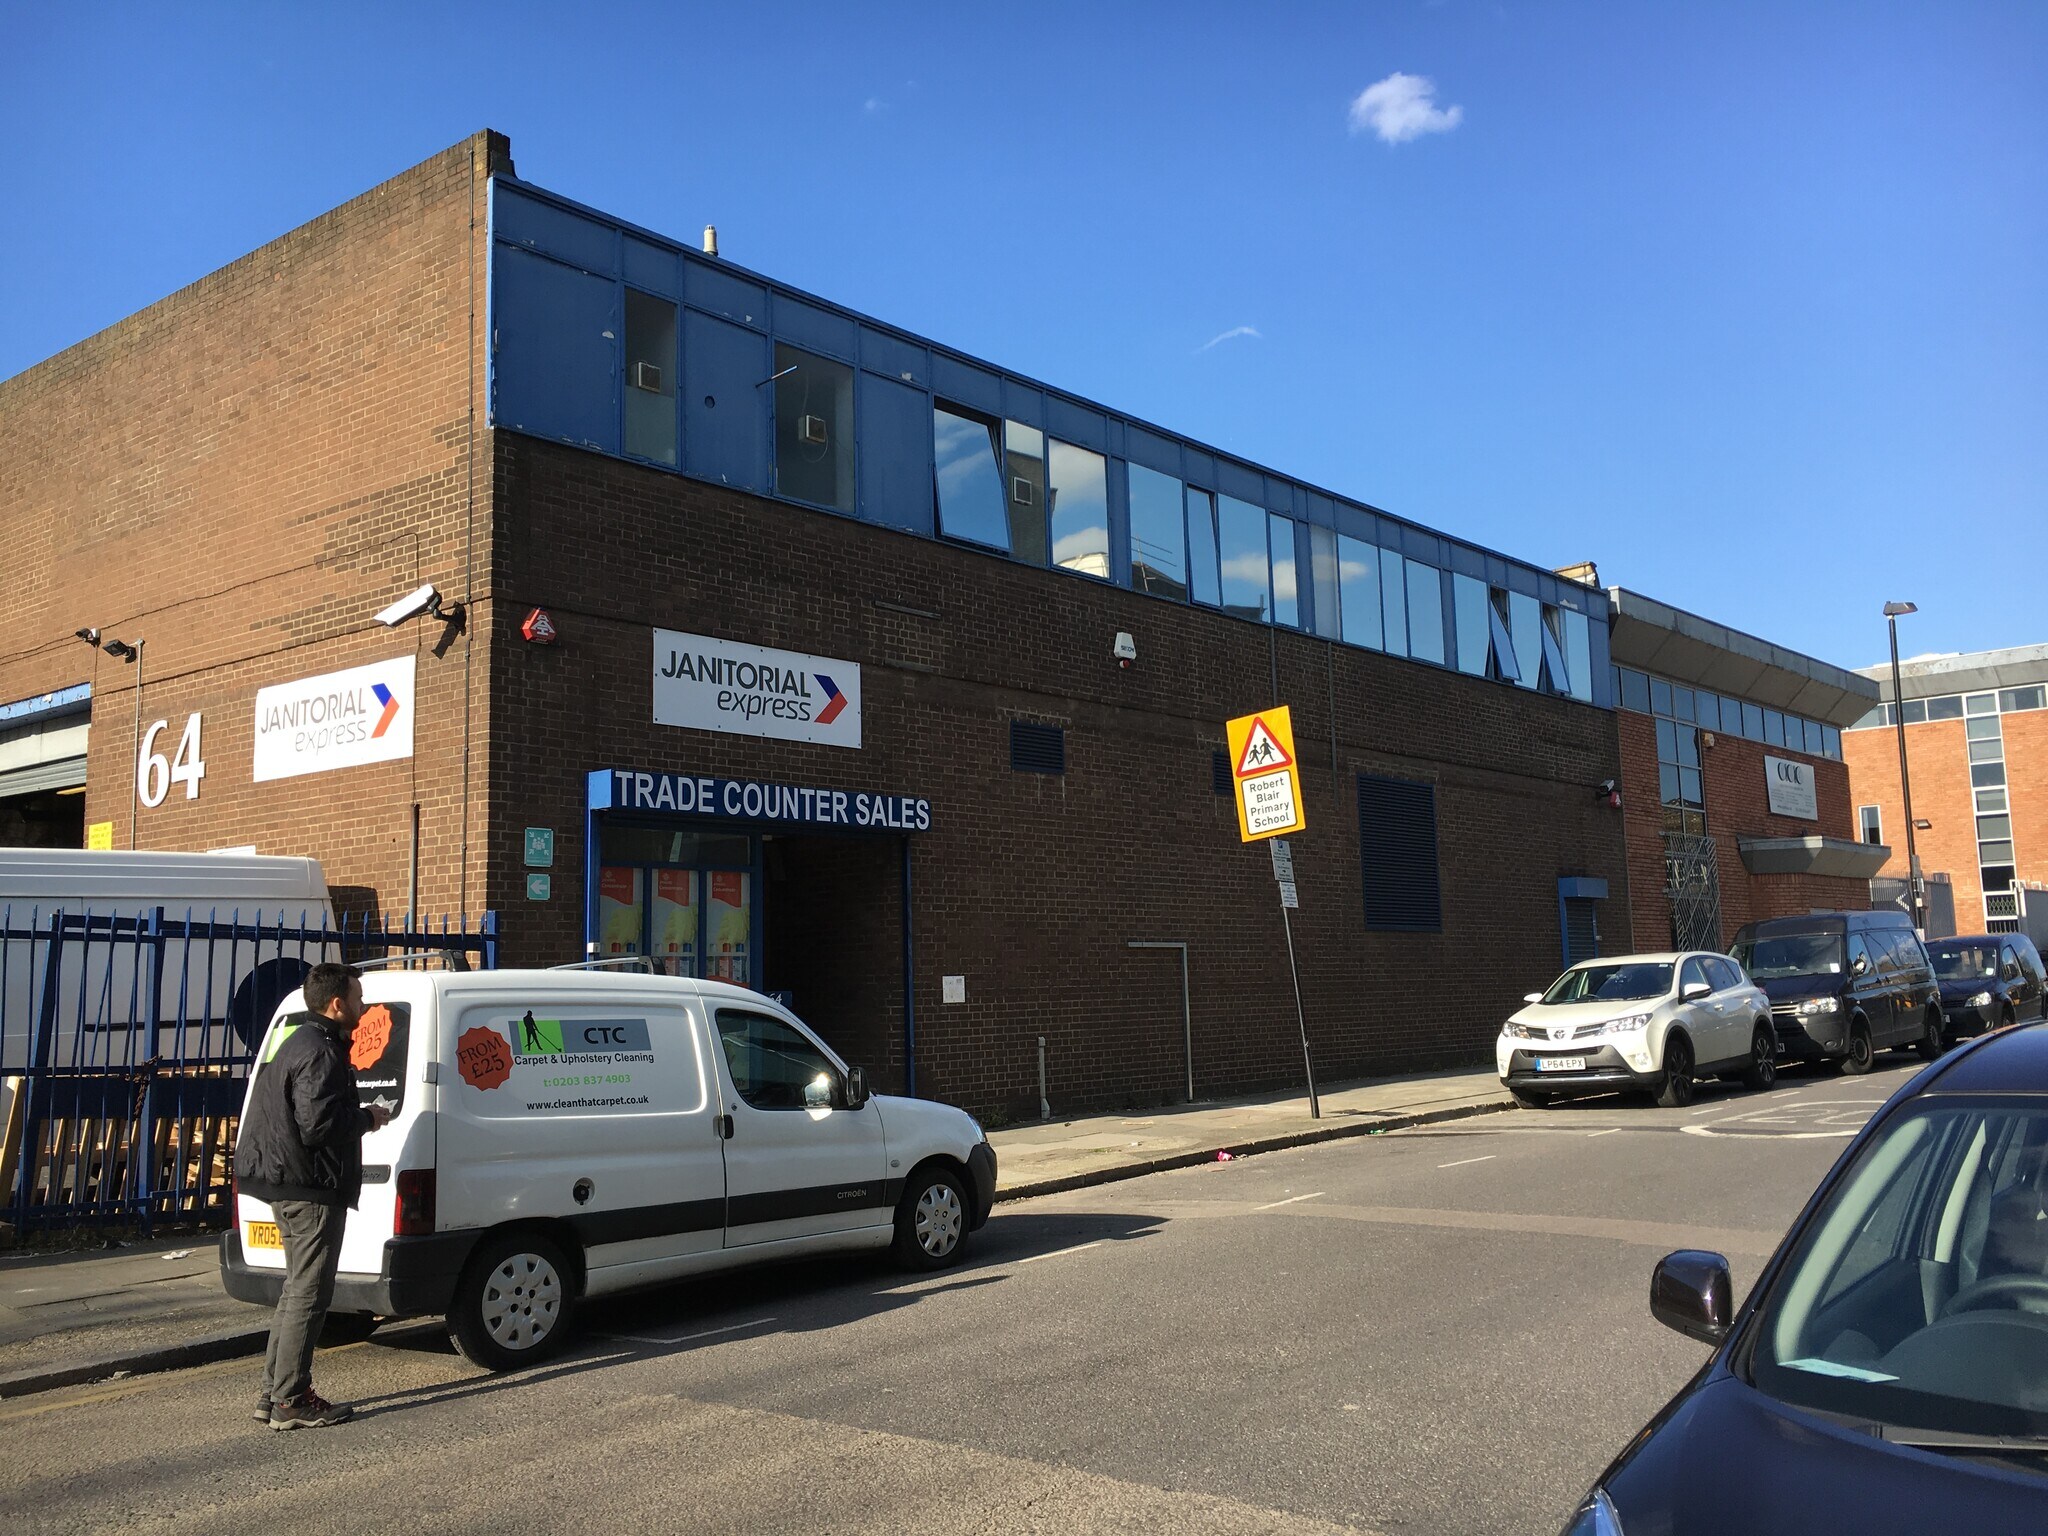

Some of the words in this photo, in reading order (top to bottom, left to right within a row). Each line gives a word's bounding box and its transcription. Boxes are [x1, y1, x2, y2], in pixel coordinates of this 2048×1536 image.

[661, 650, 811, 698] JANITORIAL
[260, 687, 367, 735] JANITORIAL
[717, 689, 811, 721] express
[294, 718, 367, 756] express
[137, 711, 206, 808] 64
[1249, 777, 1284, 793] Robert
[1256, 790, 1280, 803] Blair
[615, 770, 715, 813] TRADE
[723, 781, 849, 825] COUNTER
[855, 793, 931, 831] SALES
[1250, 802, 1290, 817] Primary
[1254, 812, 1289, 828] School
[355, 1014, 386, 1043] FROM
[583, 1026, 627, 1045] CTC
[357, 1031, 382, 1058] £25
[459, 1036, 502, 1064] FROM
[471, 1054, 506, 1079] £25
[515, 1054, 548, 1066] Carpet
[550, 1054, 559, 1065] &
[561, 1053, 612, 1066] Upholstery
[614, 1052, 655, 1064] Cleaning
[1541, 1060, 1564, 1069] LP64
[1566, 1059, 1583, 1068] EPX
[583, 1075, 603, 1086] 837
[605, 1074, 631, 1085] 4903
[526, 1095, 649, 1111] www.cleanthatcarpet.co.uk
[251, 1225, 277, 1246] YR05
